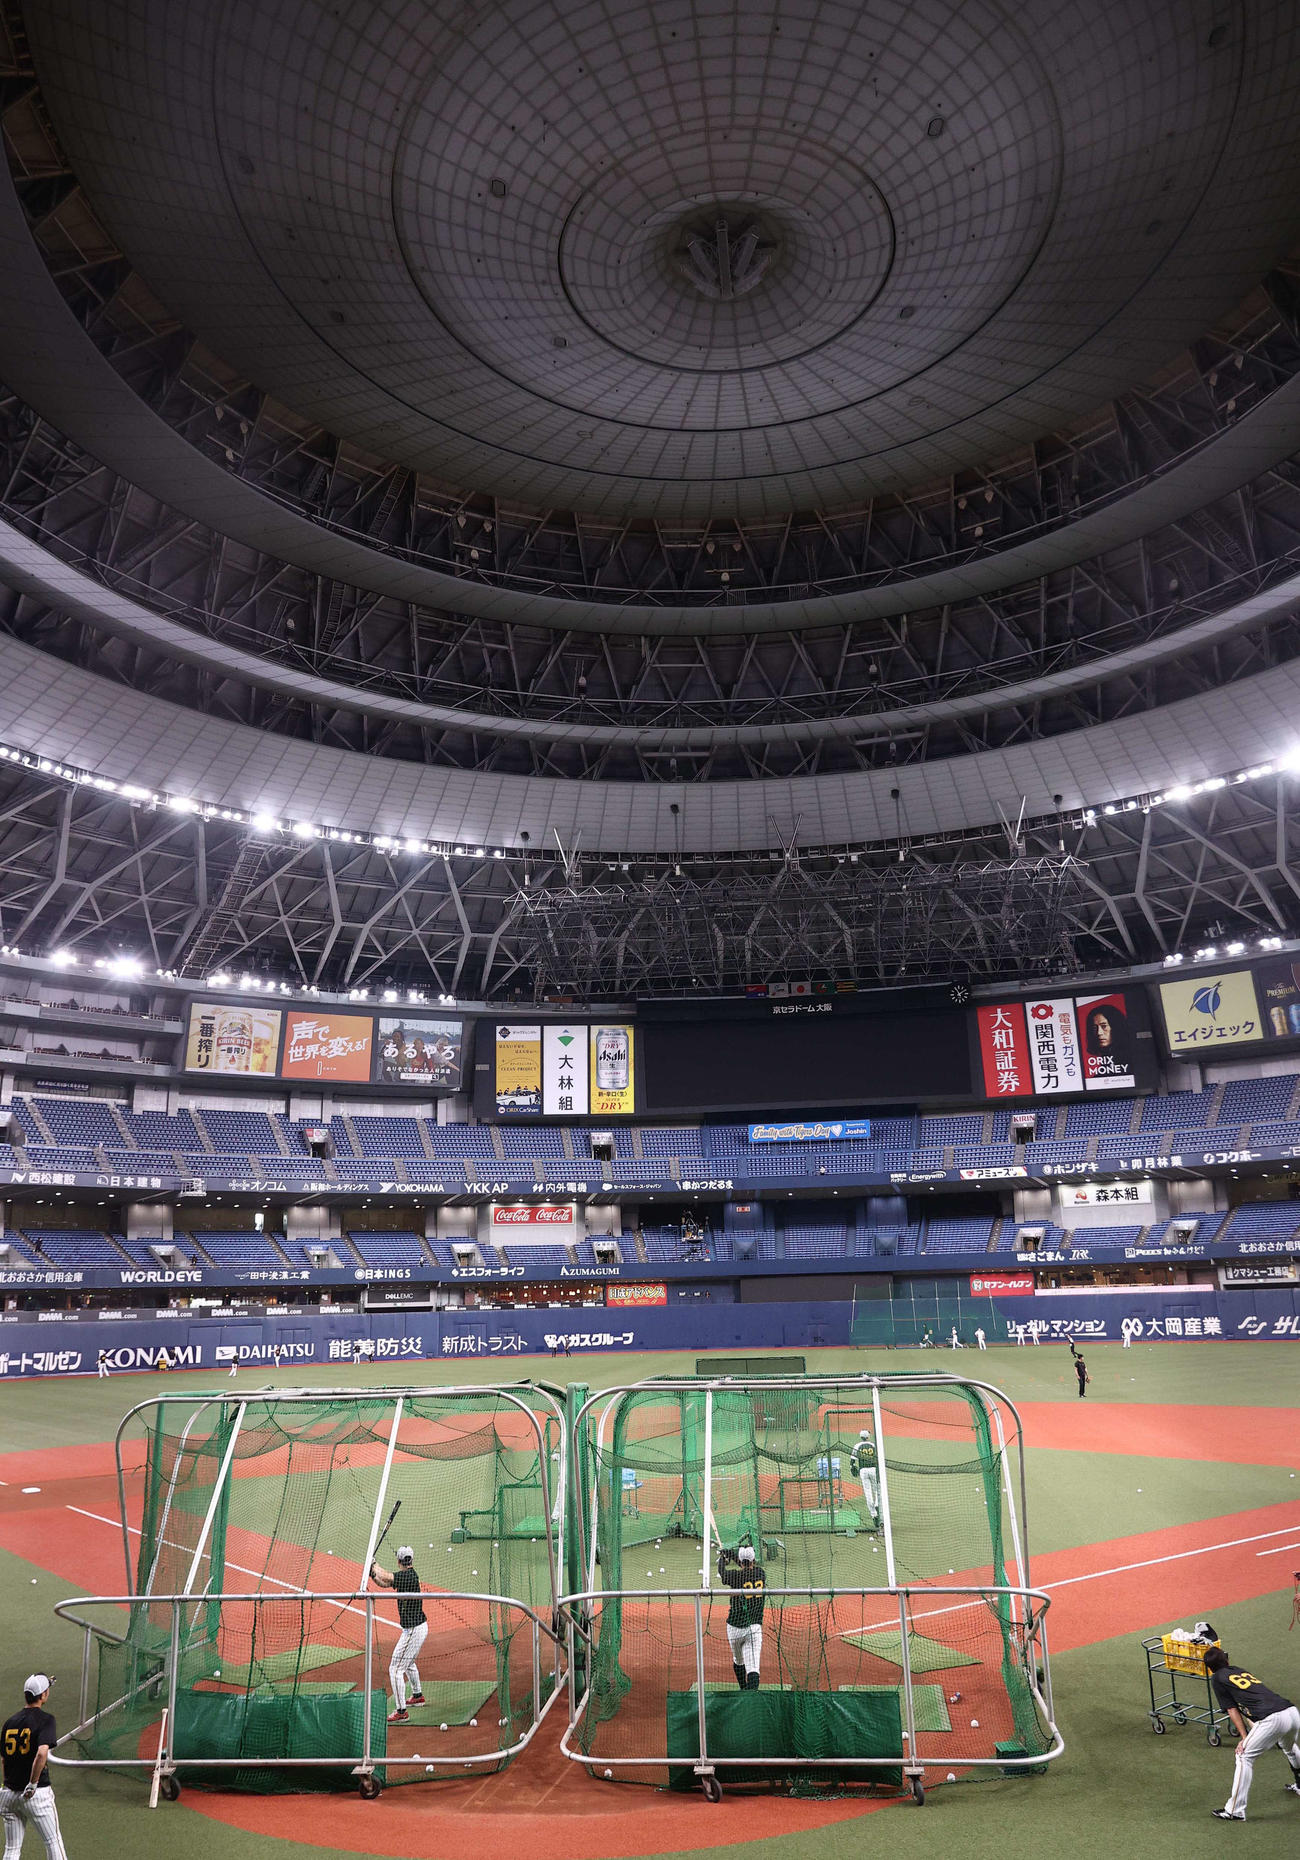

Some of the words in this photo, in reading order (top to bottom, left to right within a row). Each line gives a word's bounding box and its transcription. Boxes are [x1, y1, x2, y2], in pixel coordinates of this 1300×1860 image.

[1266, 985, 1296, 997] PREMIUM
[773, 1003, 833, 1014] 京セラドーム大阪
[290, 1020, 330, 1046] 声で
[1174, 1021, 1255, 1043] エイジェック
[197, 1015, 216, 1068] 一番搾り
[1058, 1013, 1076, 1077] 電気もガスも
[383, 1042, 455, 1060] あるやろ
[599, 1049, 627, 1061] Asahi
[990, 1008, 1020, 1094] 大和証券
[1035, 1023, 1059, 1089] 関西電力
[1087, 1055, 1114, 1066] ORIX
[1089, 1064, 1129, 1075] MONEY
[558, 1054, 574, 1110] 大林組
[1013, 1115, 1036, 1123] KIRIN
[752, 1125, 778, 1140] Family
[779, 1126, 794, 1137] with
[794, 1125, 813, 1140] Tigers
[814, 1124, 830, 1138] Day
[845, 1127, 867, 1135] Joshin
[1132, 1155, 1183, 1169] 卯月林業
[1216, 1150, 1262, 1163] コクホー
[976, 1168, 1013, 1178] アミューズ
[1054, 1161, 1099, 1174] ホシザキ
[29, 1173, 76, 1185] 西松建設
[111, 1176, 161, 1188] 日本建物
[911, 1172, 944, 1181] Energywith
[251, 1181, 287, 1191] オノコム
[394, 1183, 444, 1192] YOKOHAMA
[464, 1183, 491, 1194] YKK
[491, 1183, 508, 1193] AP
[545, 1182, 587, 1193] 内外電機
[682, 1180, 734, 1191] 串かつだるま
[1095, 1186, 1139, 1202] 森本組
[365, 1268, 411, 1280] 日本INGS
[460, 1267, 525, 1277] エスフォーライフ
[560, 1265, 620, 1276] AZUMAGUMI
[98, 1311, 138, 1320] DMM.com
[156, 1310, 193, 1319] DMM.com
[211, 1309, 248, 1317] DMM.com
[266, 1307, 302, 1315] DMM.com
[320, 1306, 354, 1314] DMM.com
[38, 1312, 79, 1322] DMM.com
[1146, 1315, 1222, 1336] 大岡産業
[329, 1337, 423, 1358] 能美防災
[442, 1335, 528, 1354] 新成トラスト
[99, 1346, 202, 1368] KONAMI
[239, 1343, 315, 1360] DAIHATSU
[5, 1727, 32, 1756] 53
